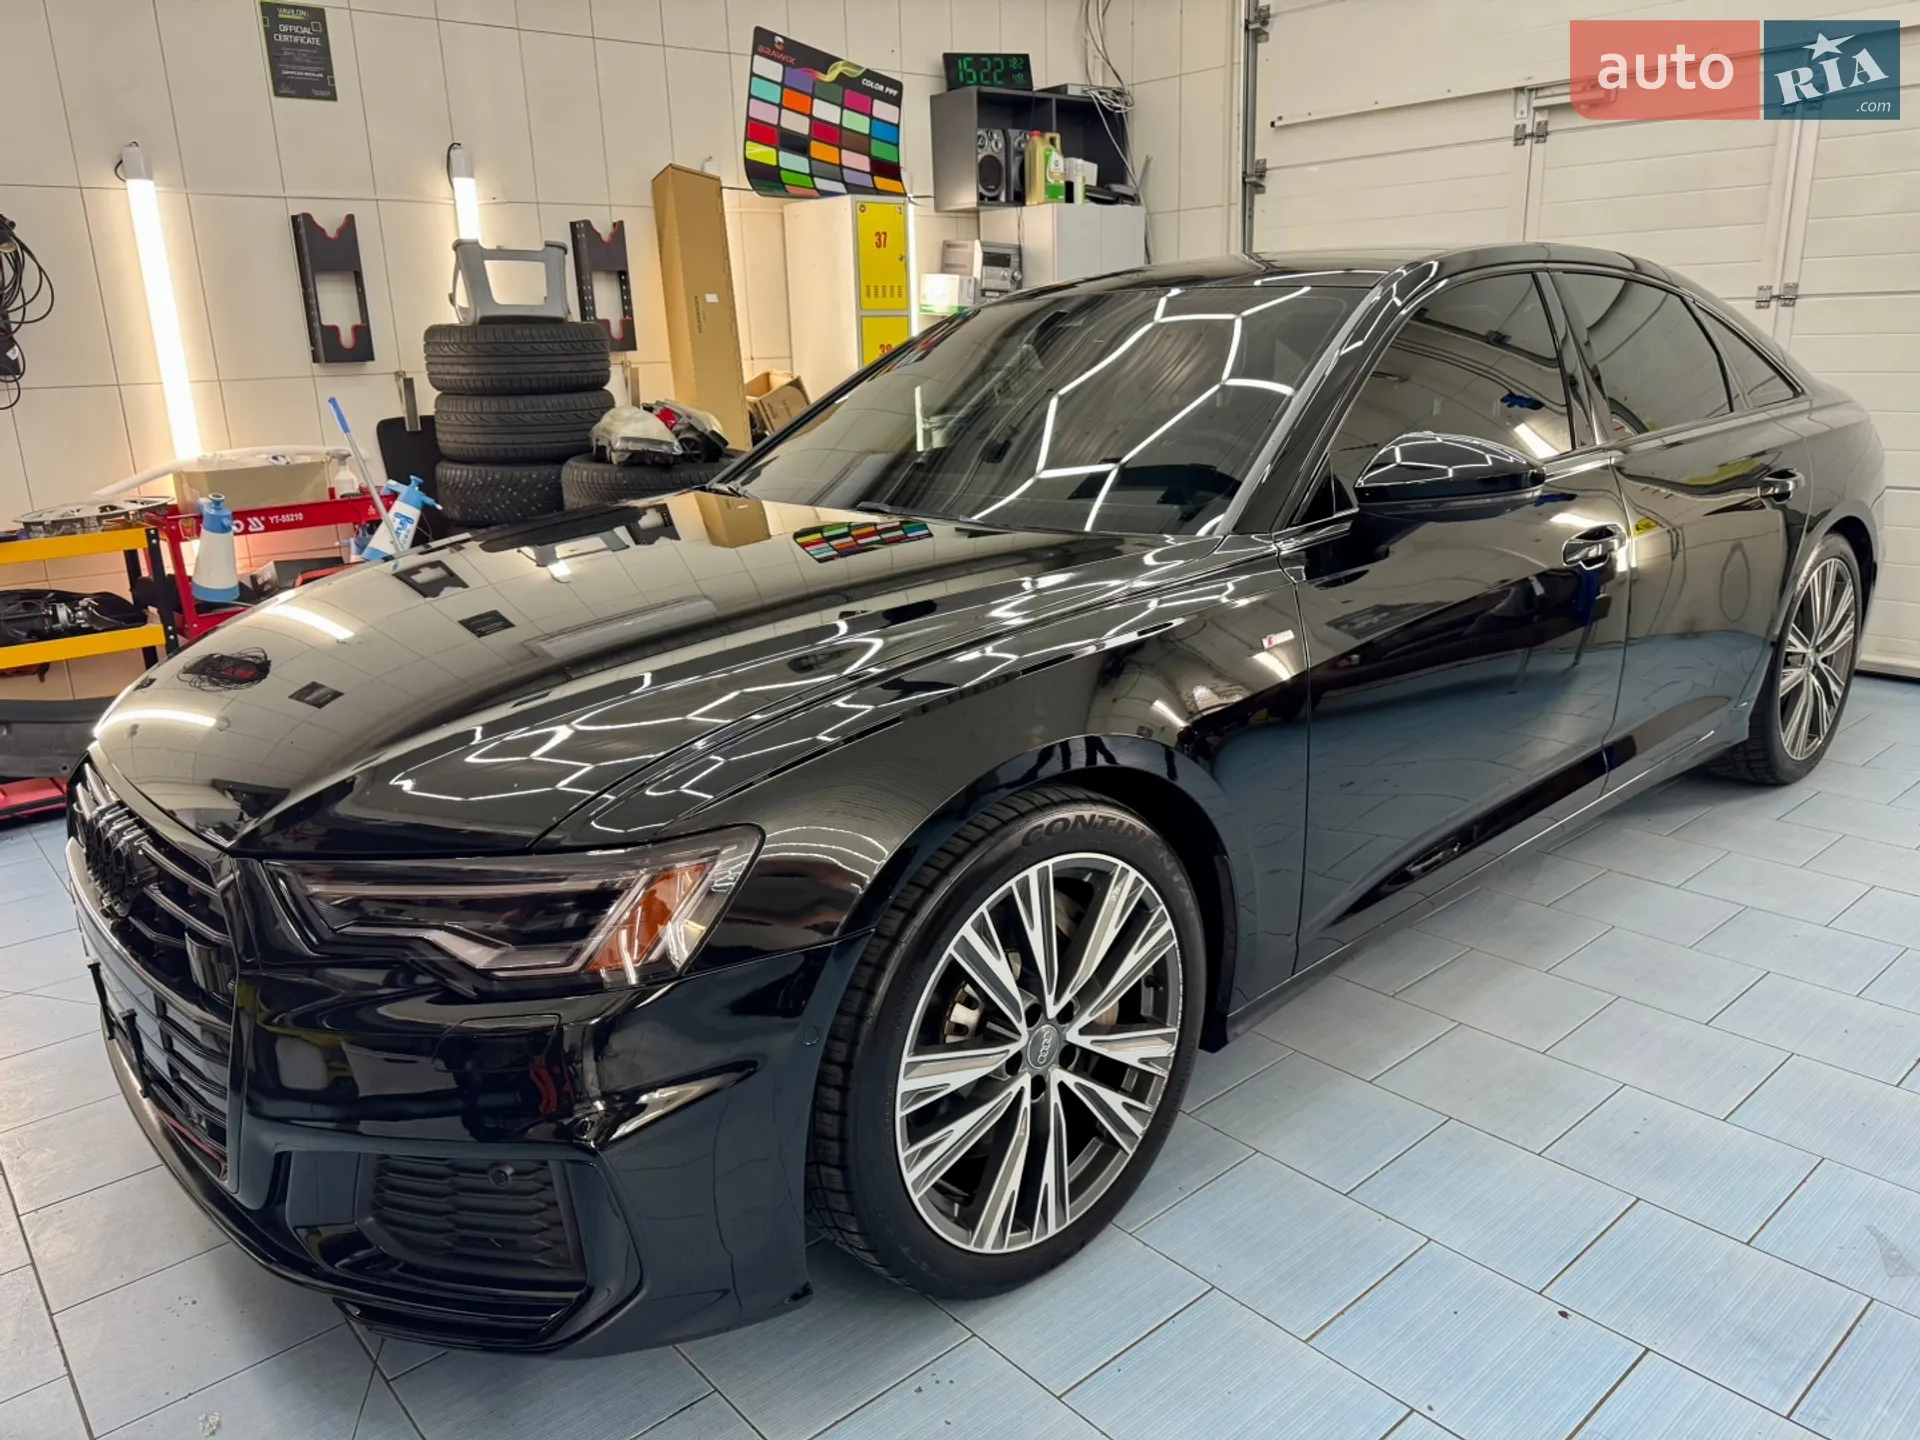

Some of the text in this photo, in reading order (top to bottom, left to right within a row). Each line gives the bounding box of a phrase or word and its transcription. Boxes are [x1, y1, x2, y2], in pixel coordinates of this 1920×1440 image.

[279, 24, 313, 35] OFFICIAL
[273, 33, 321, 46] CERTIFICATE
[758, 45, 796, 65] BRAWIX
[861, 78, 898, 97] COLOR PPF
[875, 231, 887, 249] 37
[268, 512, 304, 524] YT-55210
